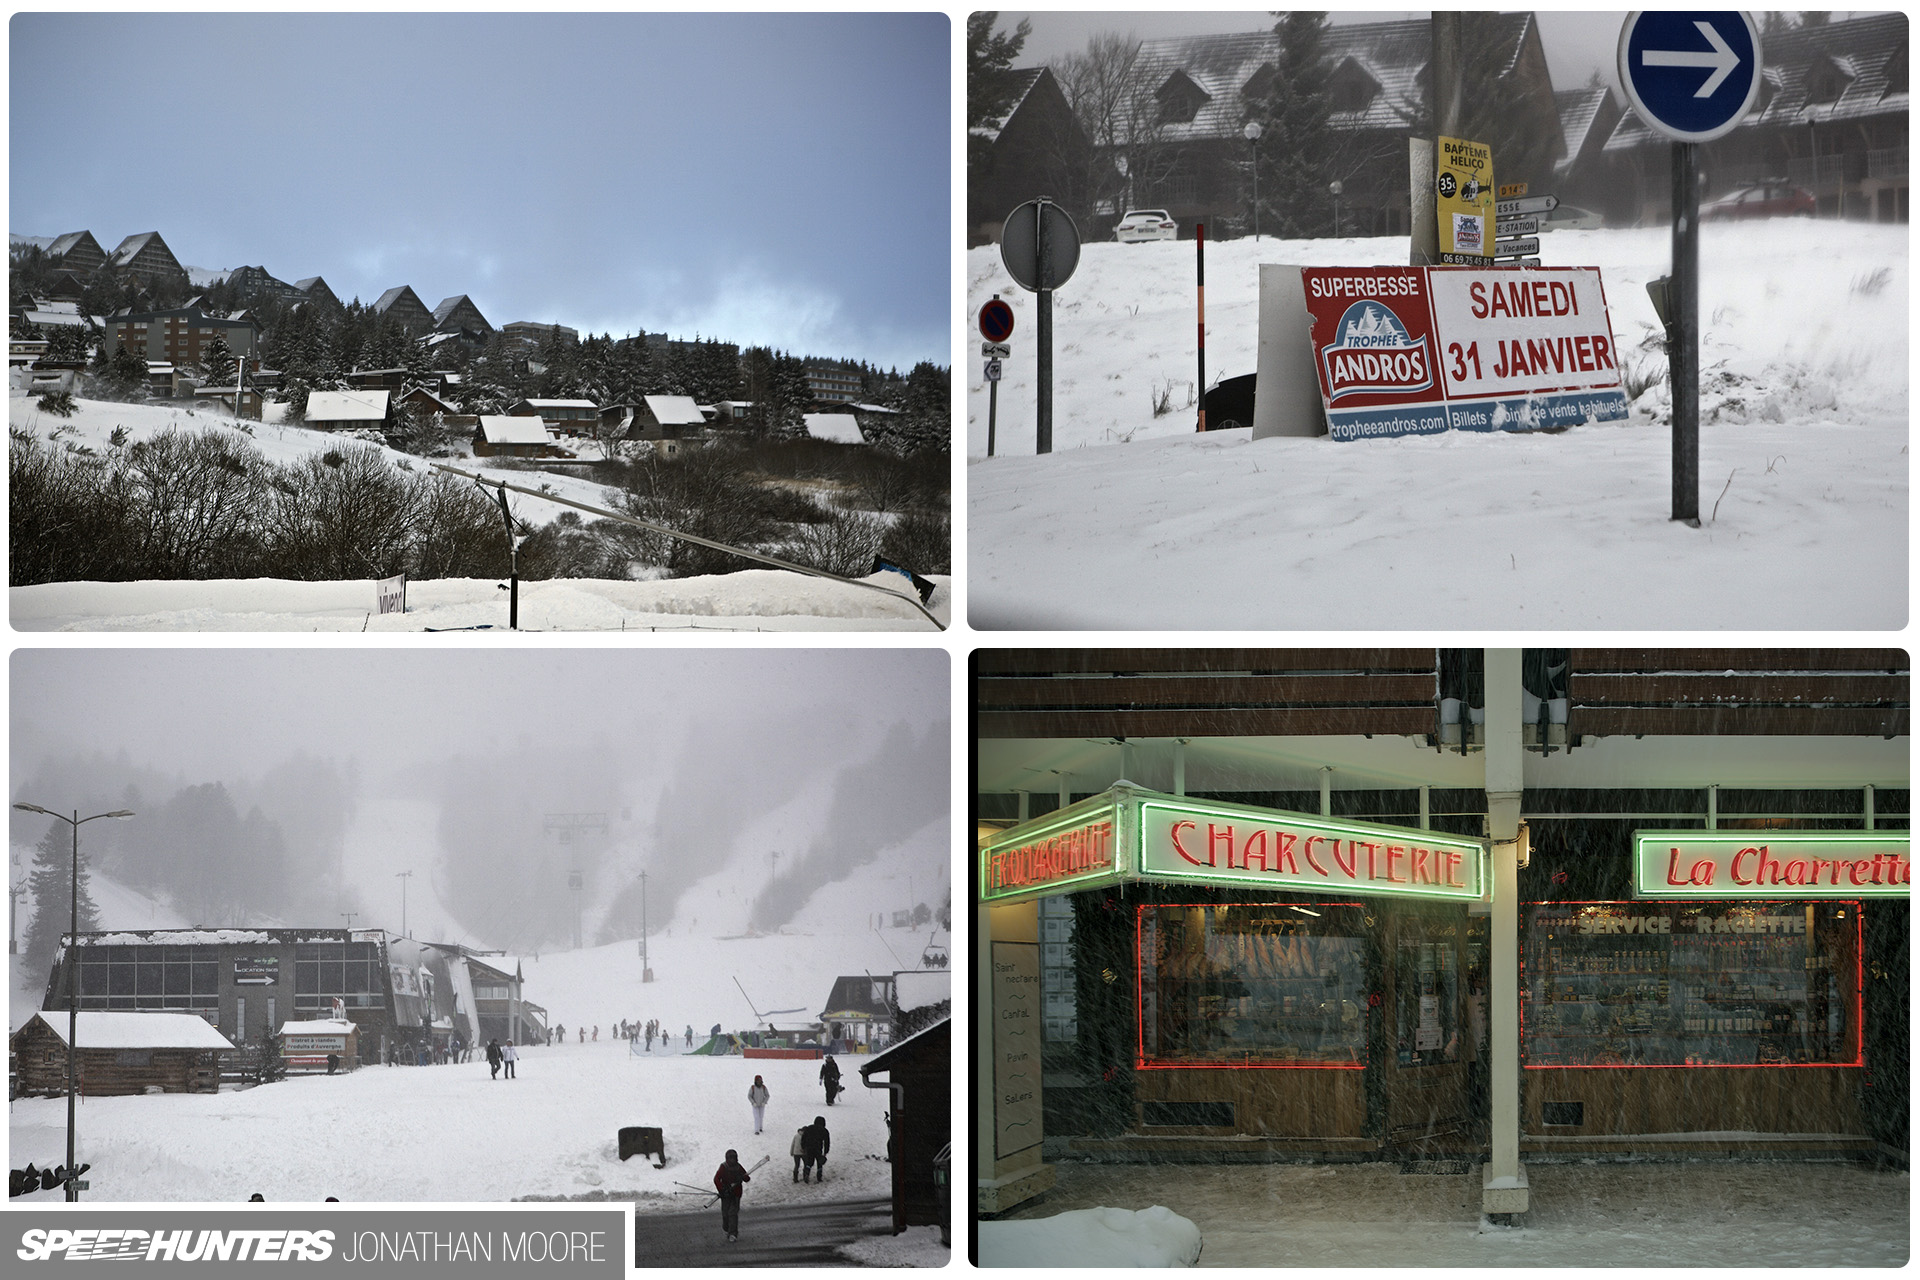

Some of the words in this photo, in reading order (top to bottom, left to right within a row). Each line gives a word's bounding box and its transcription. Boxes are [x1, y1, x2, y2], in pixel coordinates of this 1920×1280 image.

[1450, 155, 1484, 169] HELICO
[1497, 202, 1520, 213] ESSE
[1545, 199, 1551, 207] 6
[1443, 253, 1454, 263] 06
[1454, 254, 1464, 264] 69
[1503, 244, 1536, 253] Vacances
[1311, 275, 1420, 299] SUPERBESSE
[1469, 280, 1579, 320] SAMEDI
[1346, 331, 1398, 349] TROPHÉE
[1333, 350, 1425, 386] ANDROS
[1448, 340, 1483, 383] 31
[1493, 334, 1615, 379] JANVIER
[1451, 410, 1487, 428] Billets
[1534, 405, 1547, 420] de
[1548, 402, 1578, 418] vente
[1579, 398, 1625, 416] habituels
[1331, 416, 1446, 440] tropheeandros.com
[991, 822, 1112, 889] FROMAGERIE
[1170, 820, 1467, 889] CHARCUTERIE
[1666, 848, 1717, 887] La
[1578, 916, 1672, 934] SERVICE
[1698, 916, 1807, 934] RACLETTE
[995, 962, 1016, 973] Saint
[1006, 975, 1039, 983] nectaire
[1007, 1052, 1029, 1063] Pavin
